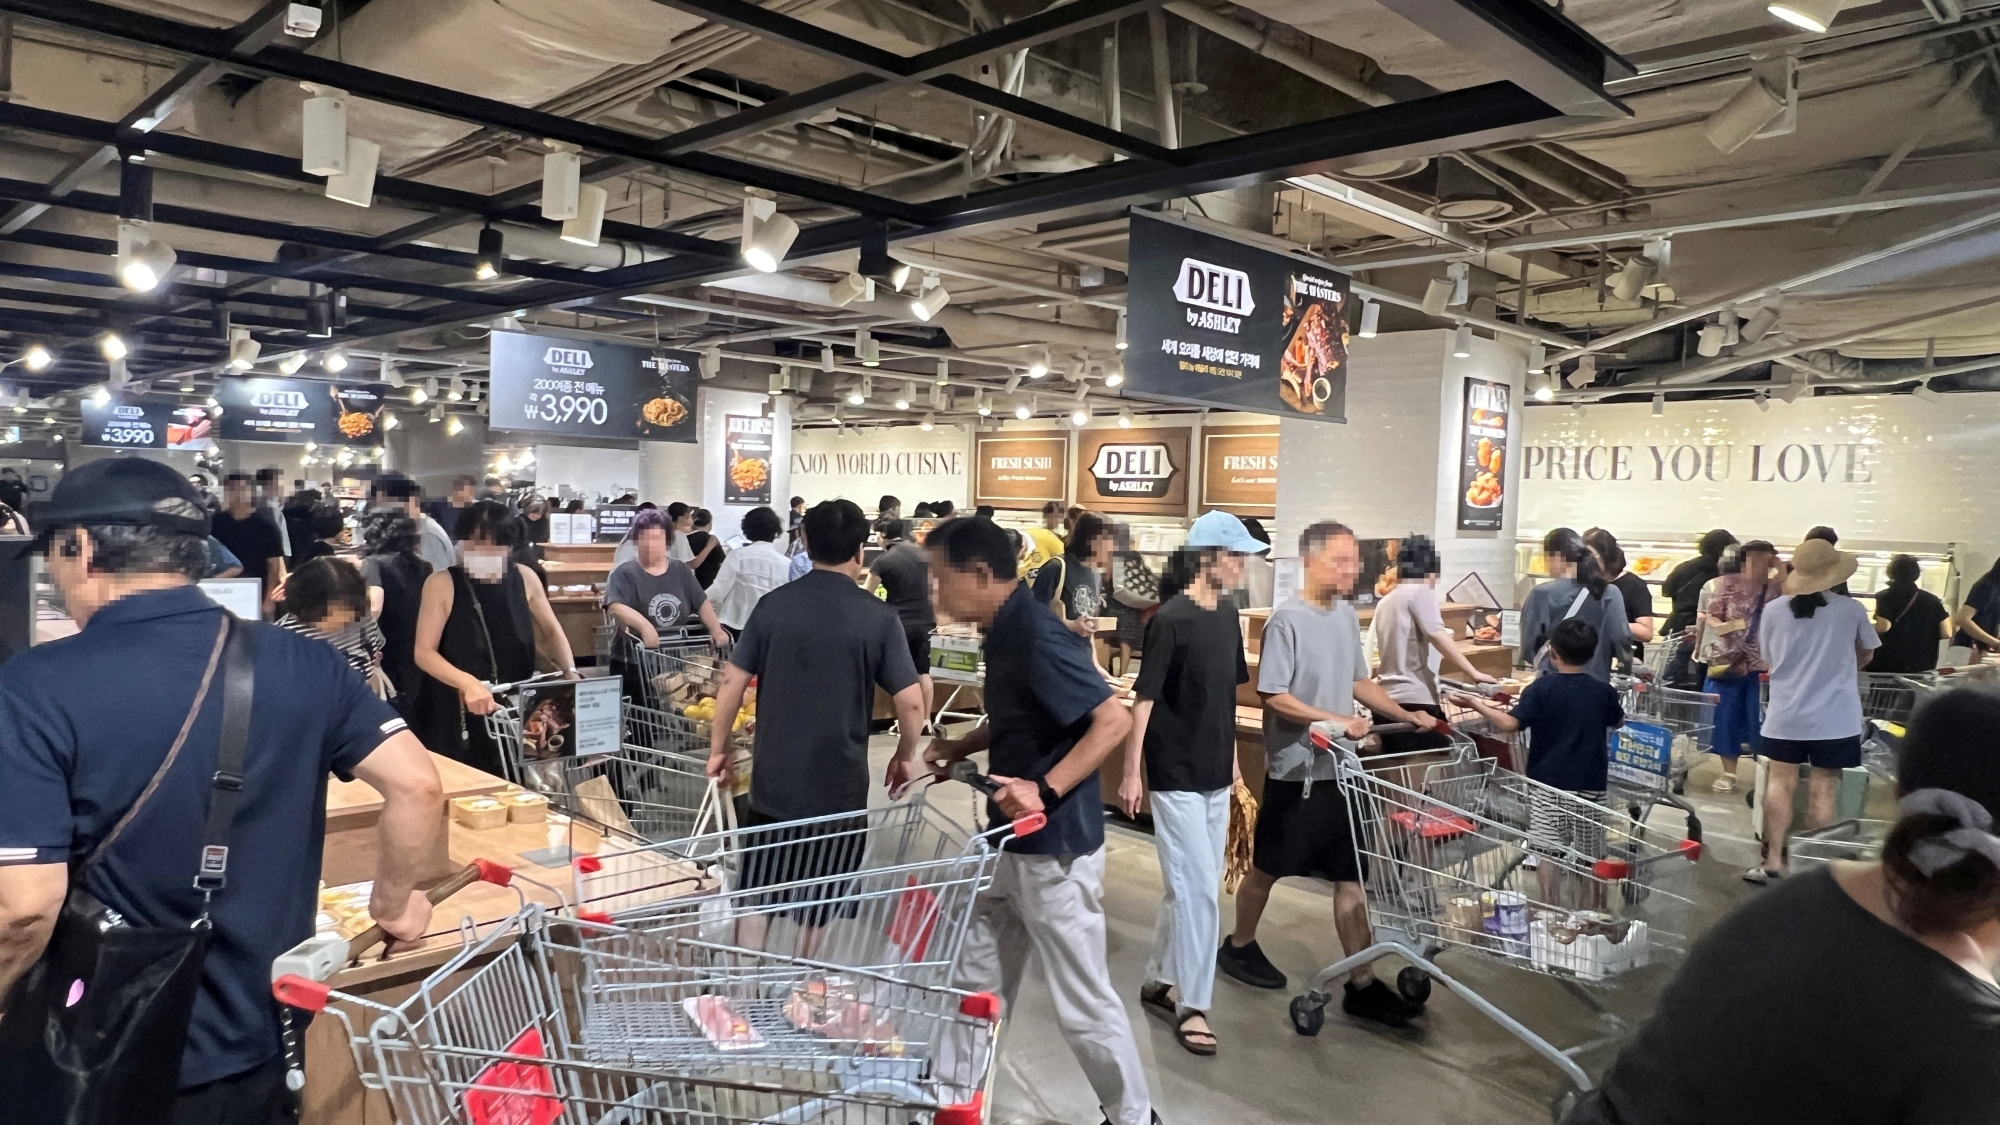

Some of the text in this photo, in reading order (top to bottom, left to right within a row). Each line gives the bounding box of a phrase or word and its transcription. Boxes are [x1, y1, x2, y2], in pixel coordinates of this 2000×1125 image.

[1187, 265, 1243, 309] DELI
[1186, 308, 1241, 334] by ASHLEY
[551, 350, 586, 366] DELI
[1161, 339, 1178, 355] 세계
[1178, 342, 1201, 359] 요리를
[1201, 346, 1225, 363] 세상에
[259, 392, 299, 407] DELI
[573, 381, 585, 394] 전
[789, 452, 962, 476] ENJOY WORLD CUISINE
[1022, 456, 1052, 470] SUSHI
[1105, 449, 1161, 476] DELI
[1223, 455, 1267, 470] FRESH
[1520, 444, 1876, 484] PRICE YOU LOVE
